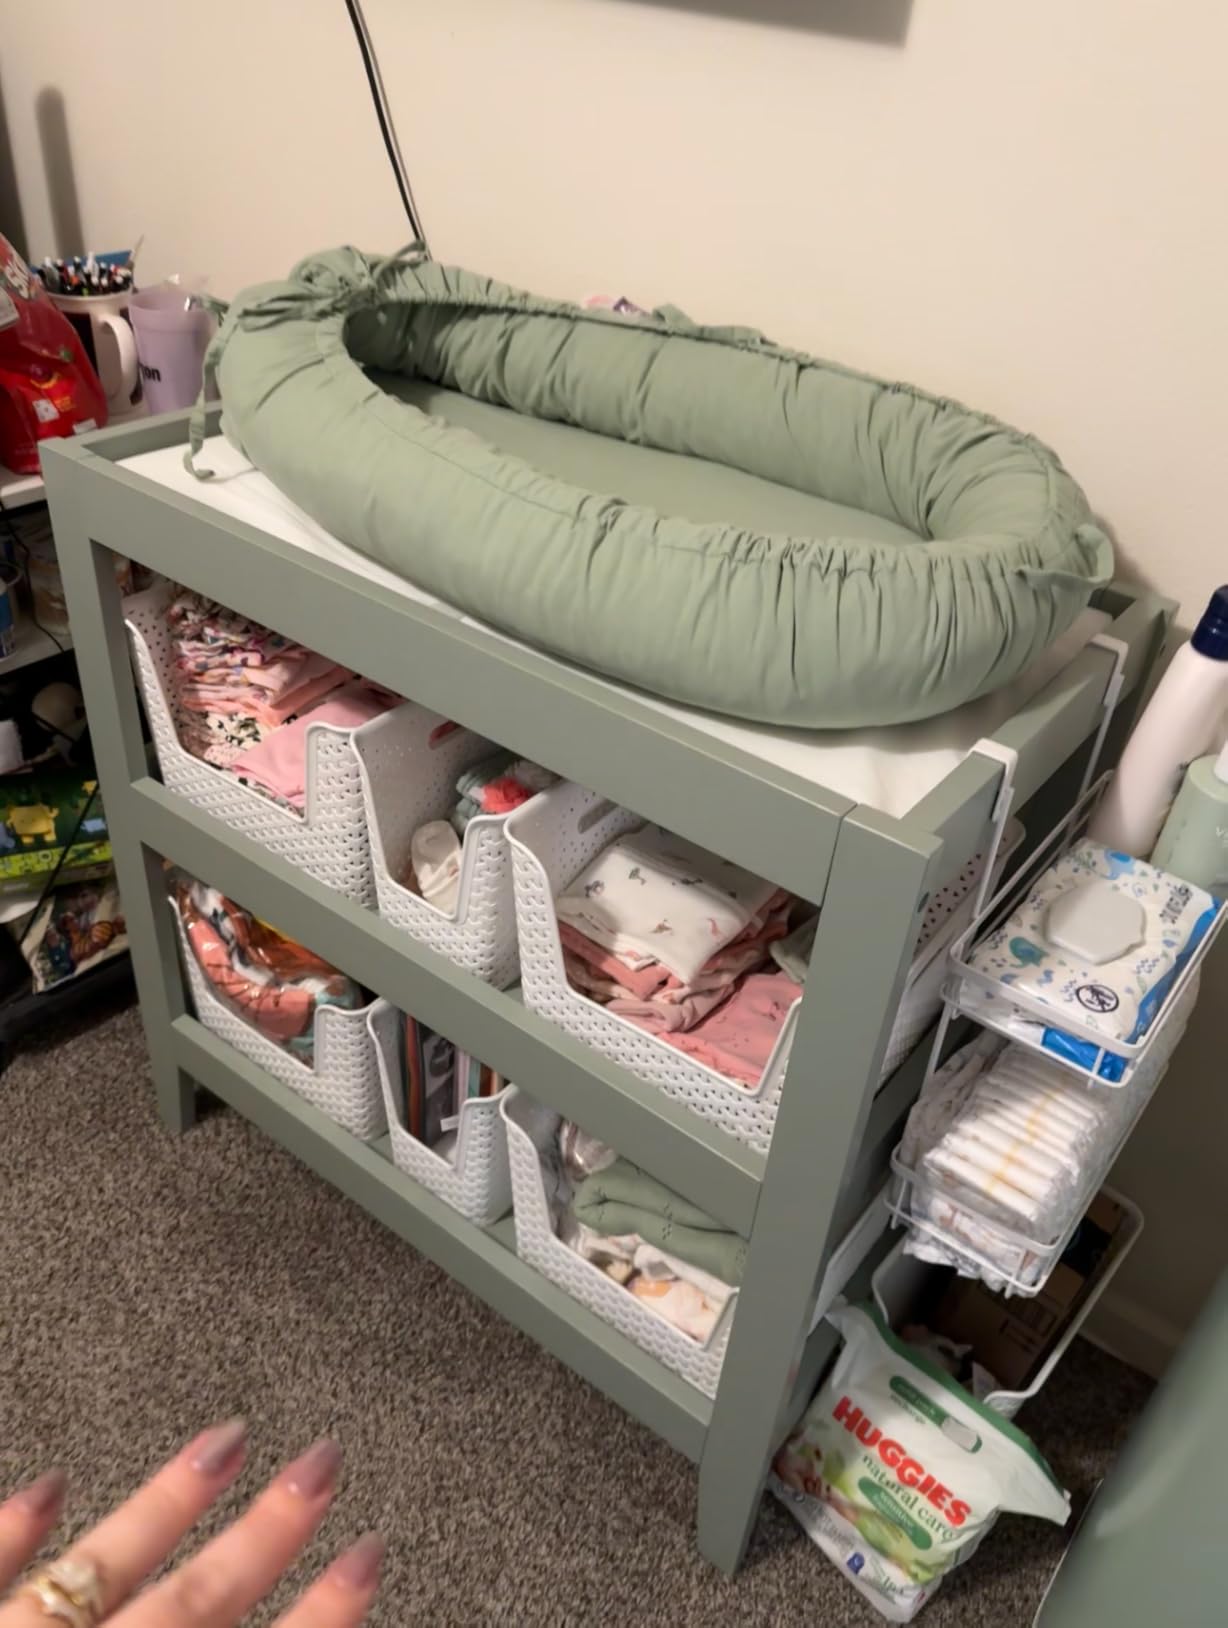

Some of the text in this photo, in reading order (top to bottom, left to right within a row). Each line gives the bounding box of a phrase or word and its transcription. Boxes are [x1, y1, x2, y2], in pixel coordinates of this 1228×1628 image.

[833, 1397, 971, 1528] HUGGIES
[863, 1455, 919, 1510] natural
[918, 1508, 953, 1541] care
